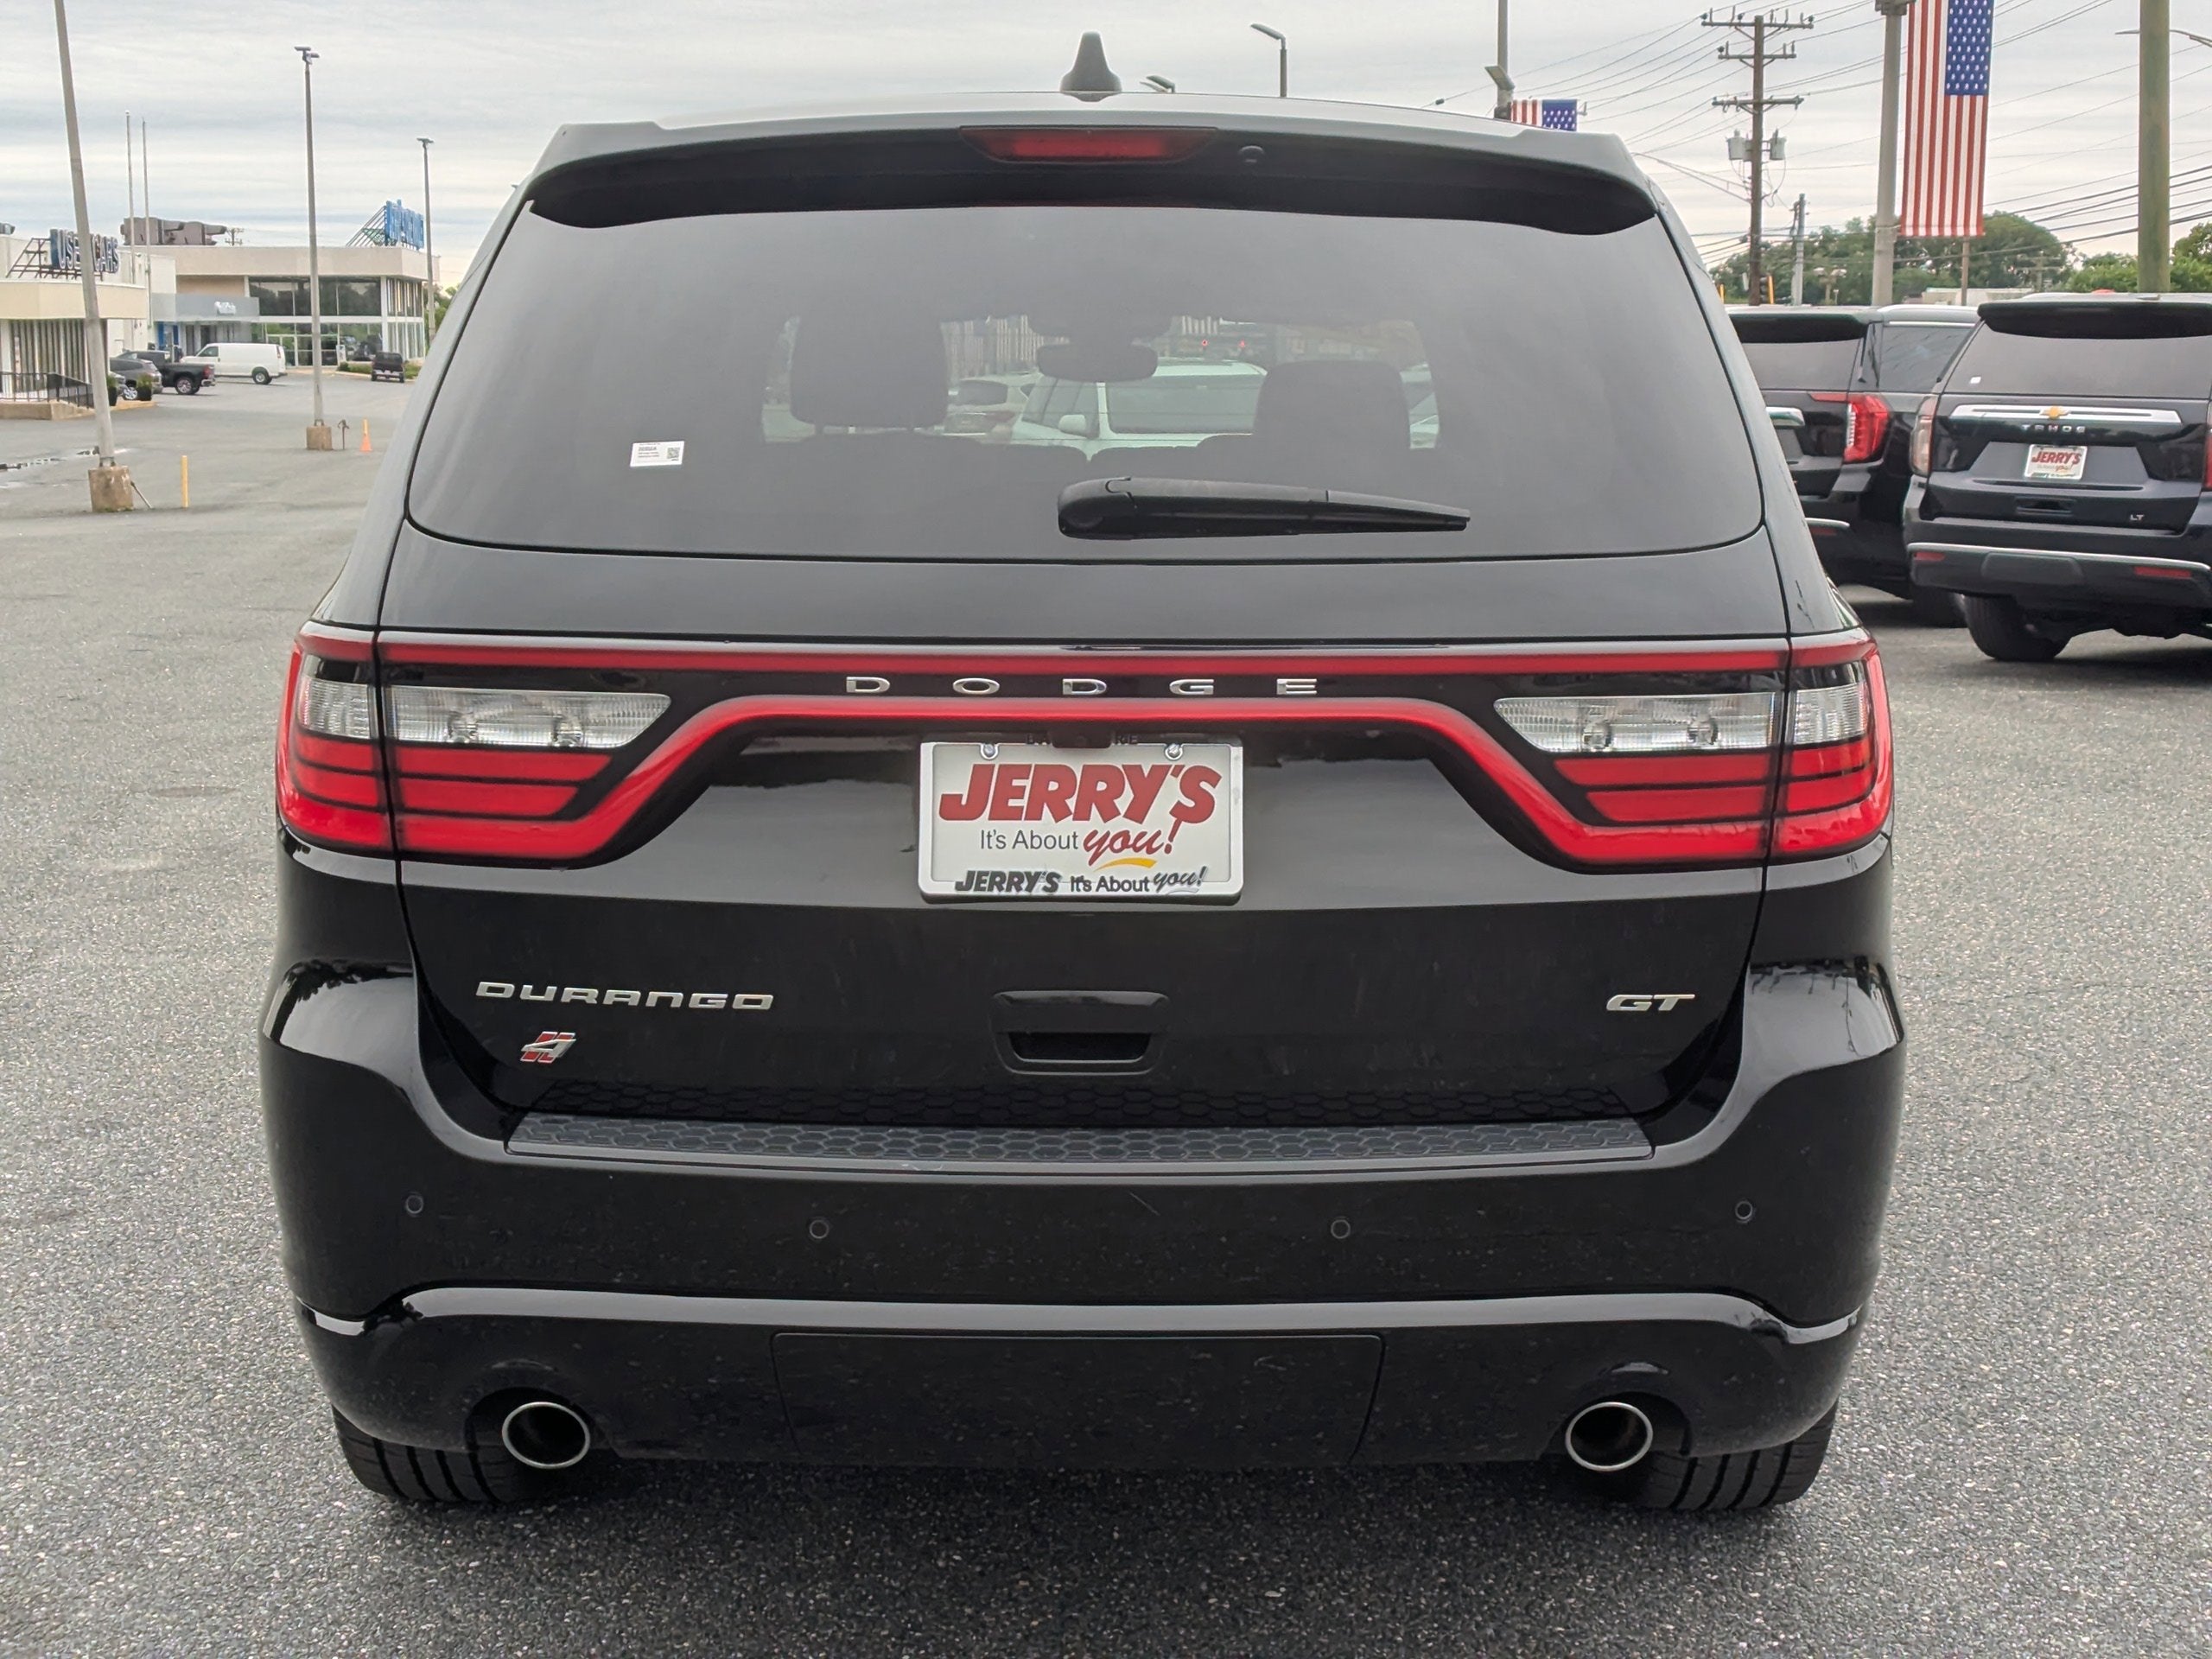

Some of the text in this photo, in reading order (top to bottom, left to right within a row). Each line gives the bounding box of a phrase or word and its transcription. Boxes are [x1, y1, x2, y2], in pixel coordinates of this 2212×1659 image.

[54, 228, 119, 273] USE CARS
[2031, 451, 2082, 465] JERRY'S
[846, 677, 1318, 696] DODGE
[938, 763, 1224, 825] JERRY'S
[980, 817, 1184, 867] It's About you!
[954, 865, 1209, 894] JERRY'S It's About you!
[475, 981, 774, 1010] DURANGO
[1605, 994, 1696, 1012] GT
